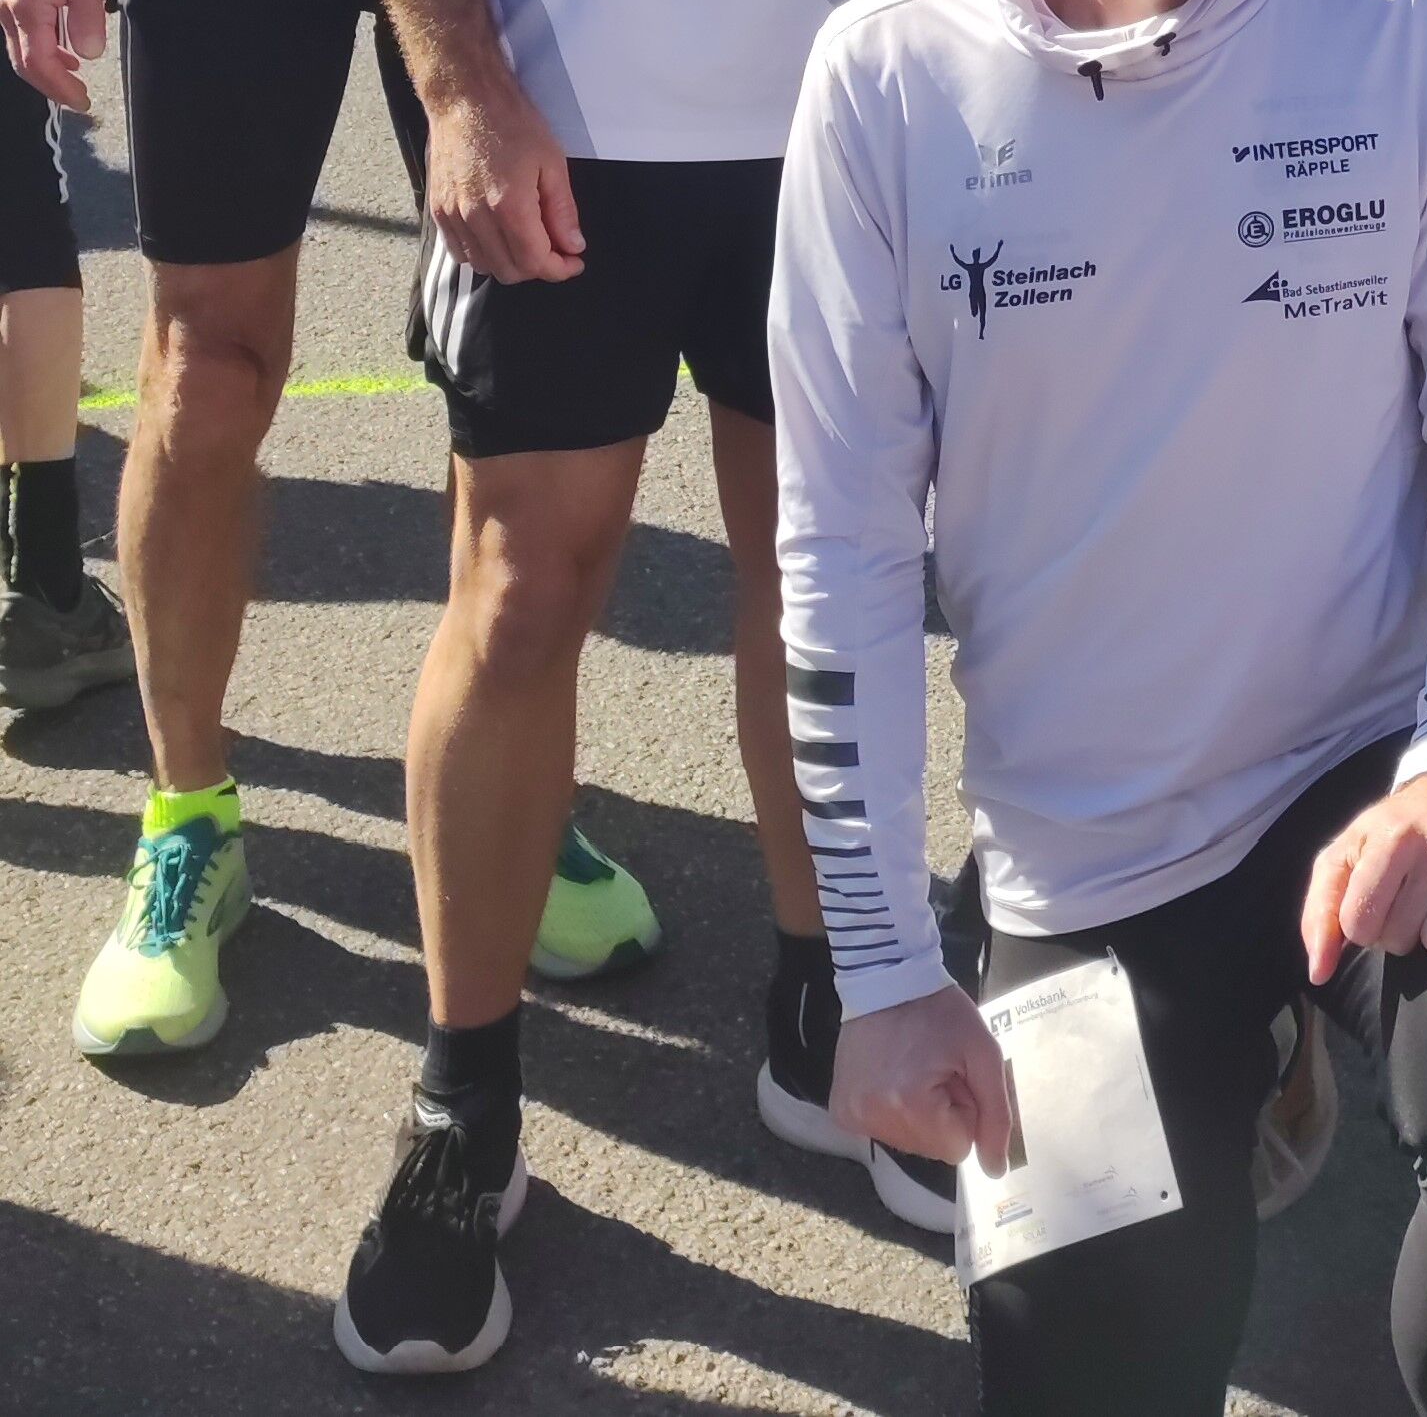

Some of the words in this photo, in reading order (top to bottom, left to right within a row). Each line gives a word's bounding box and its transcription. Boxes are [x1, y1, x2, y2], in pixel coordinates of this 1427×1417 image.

[1253, 133, 1379, 161] INTERSPORT
[965, 168, 1033, 190] erima
[1285, 159, 1350, 178] RÄPPLE
[1282, 199, 1385, 229] EROGLU
[940, 274, 962, 290] LG
[992, 261, 1097, 286] Steinlach
[994, 288, 1073, 307] Zollern
[1283, 287, 1302, 298] Bad
[1284, 290, 1388, 319] MeTraVit
[1015, 987, 1067, 1016] Volksbank
